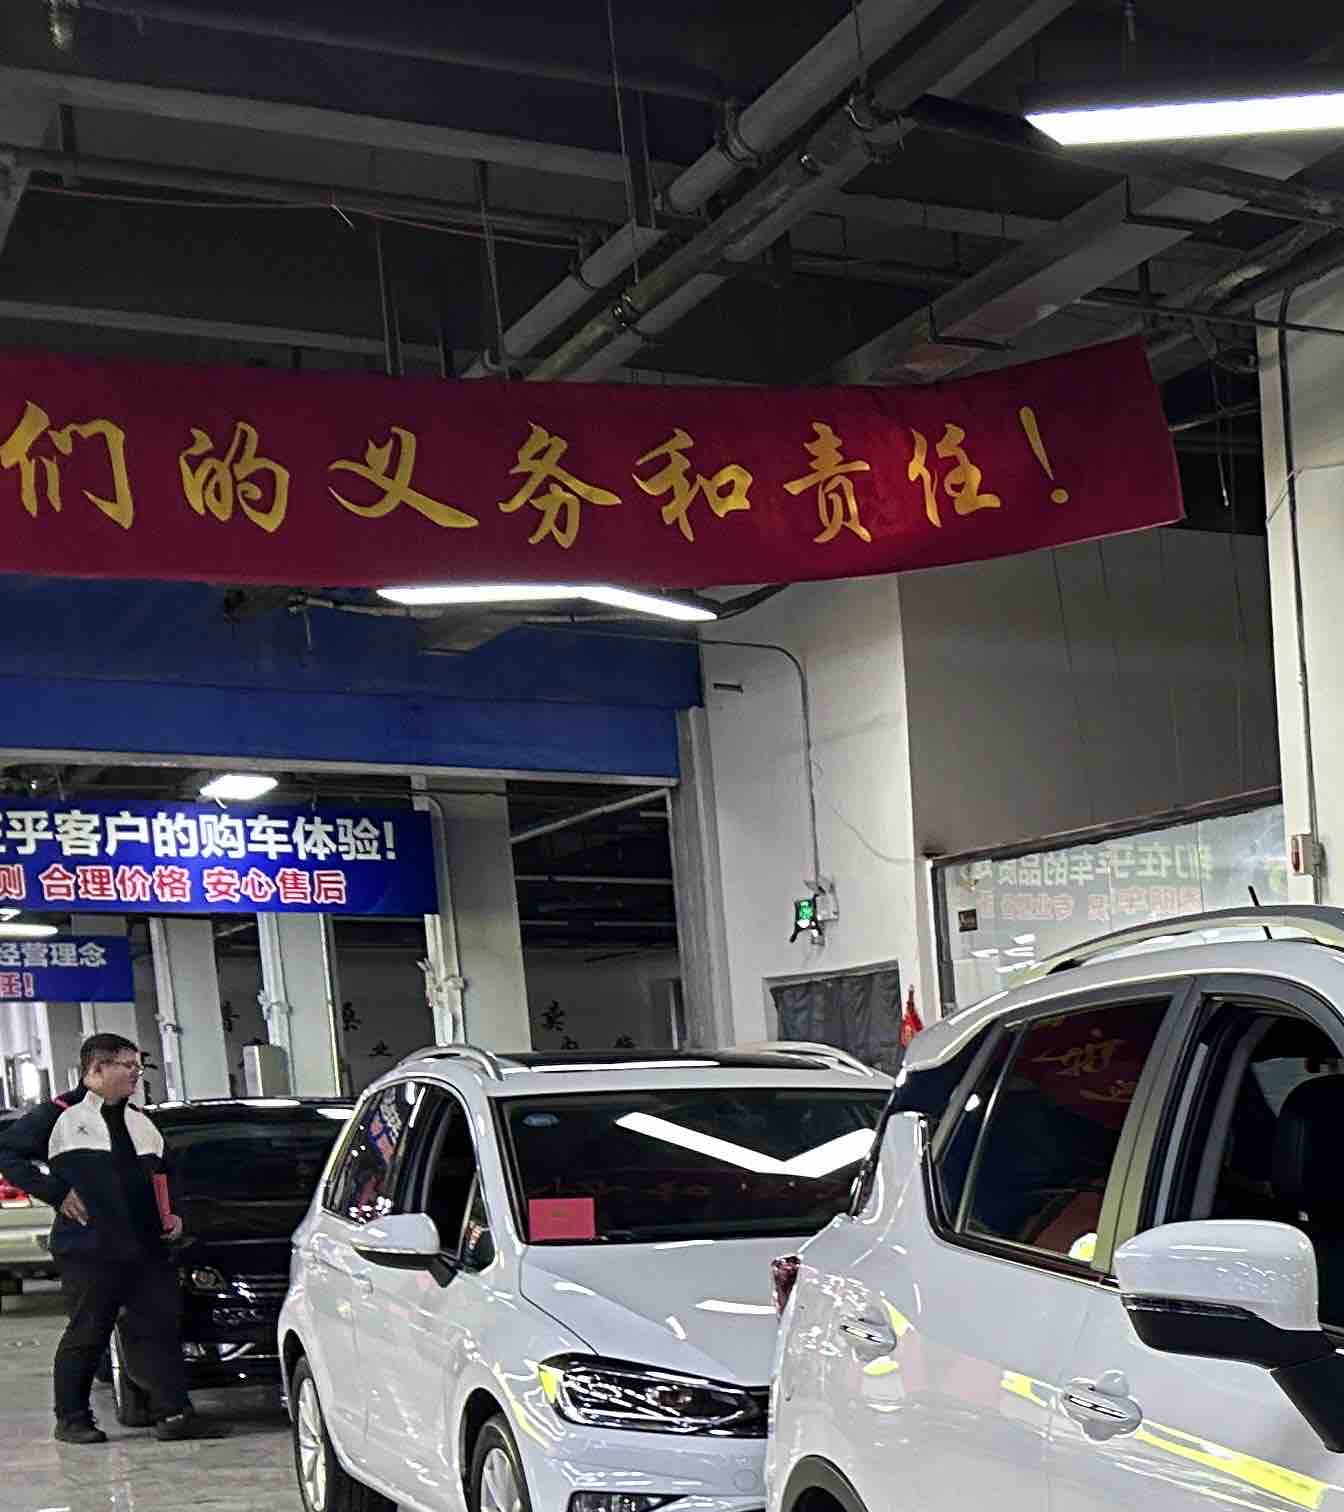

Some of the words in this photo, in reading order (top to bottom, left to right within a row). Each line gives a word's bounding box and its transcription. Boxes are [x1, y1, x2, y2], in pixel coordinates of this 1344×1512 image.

[0, 810, 397, 861] 乎客户的购车体验!
[39, 865, 191, 902] 合理价格
[203, 867, 347, 904] 安心售后
[0, 942, 107, 968] 经营理念
